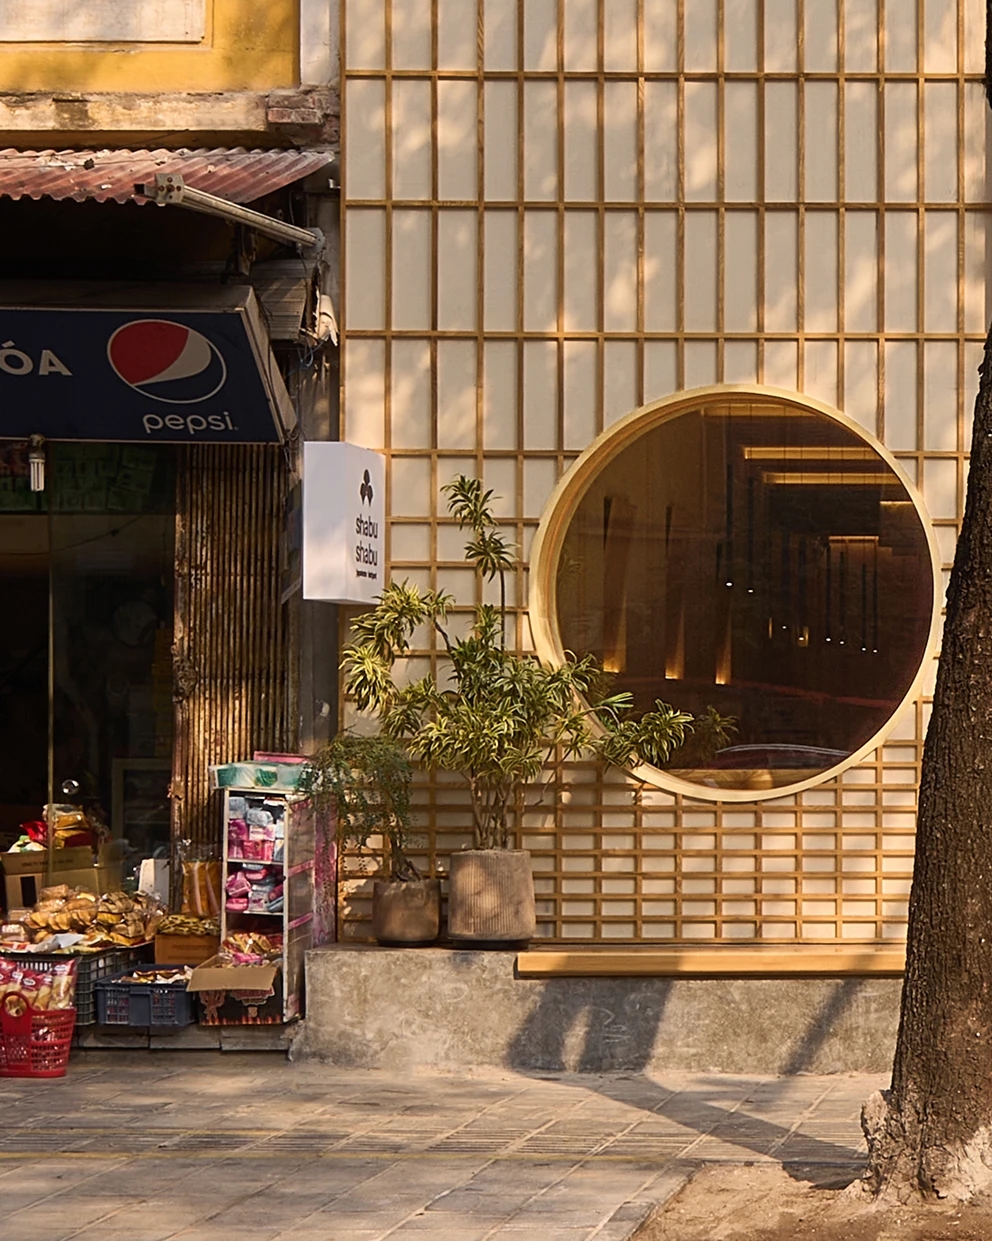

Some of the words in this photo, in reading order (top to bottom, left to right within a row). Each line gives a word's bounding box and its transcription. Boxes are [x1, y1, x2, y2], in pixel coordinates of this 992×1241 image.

[142, 411, 233, 434] pepsi
[355, 513, 378, 539] shabu
[355, 540, 378, 566] shabu
